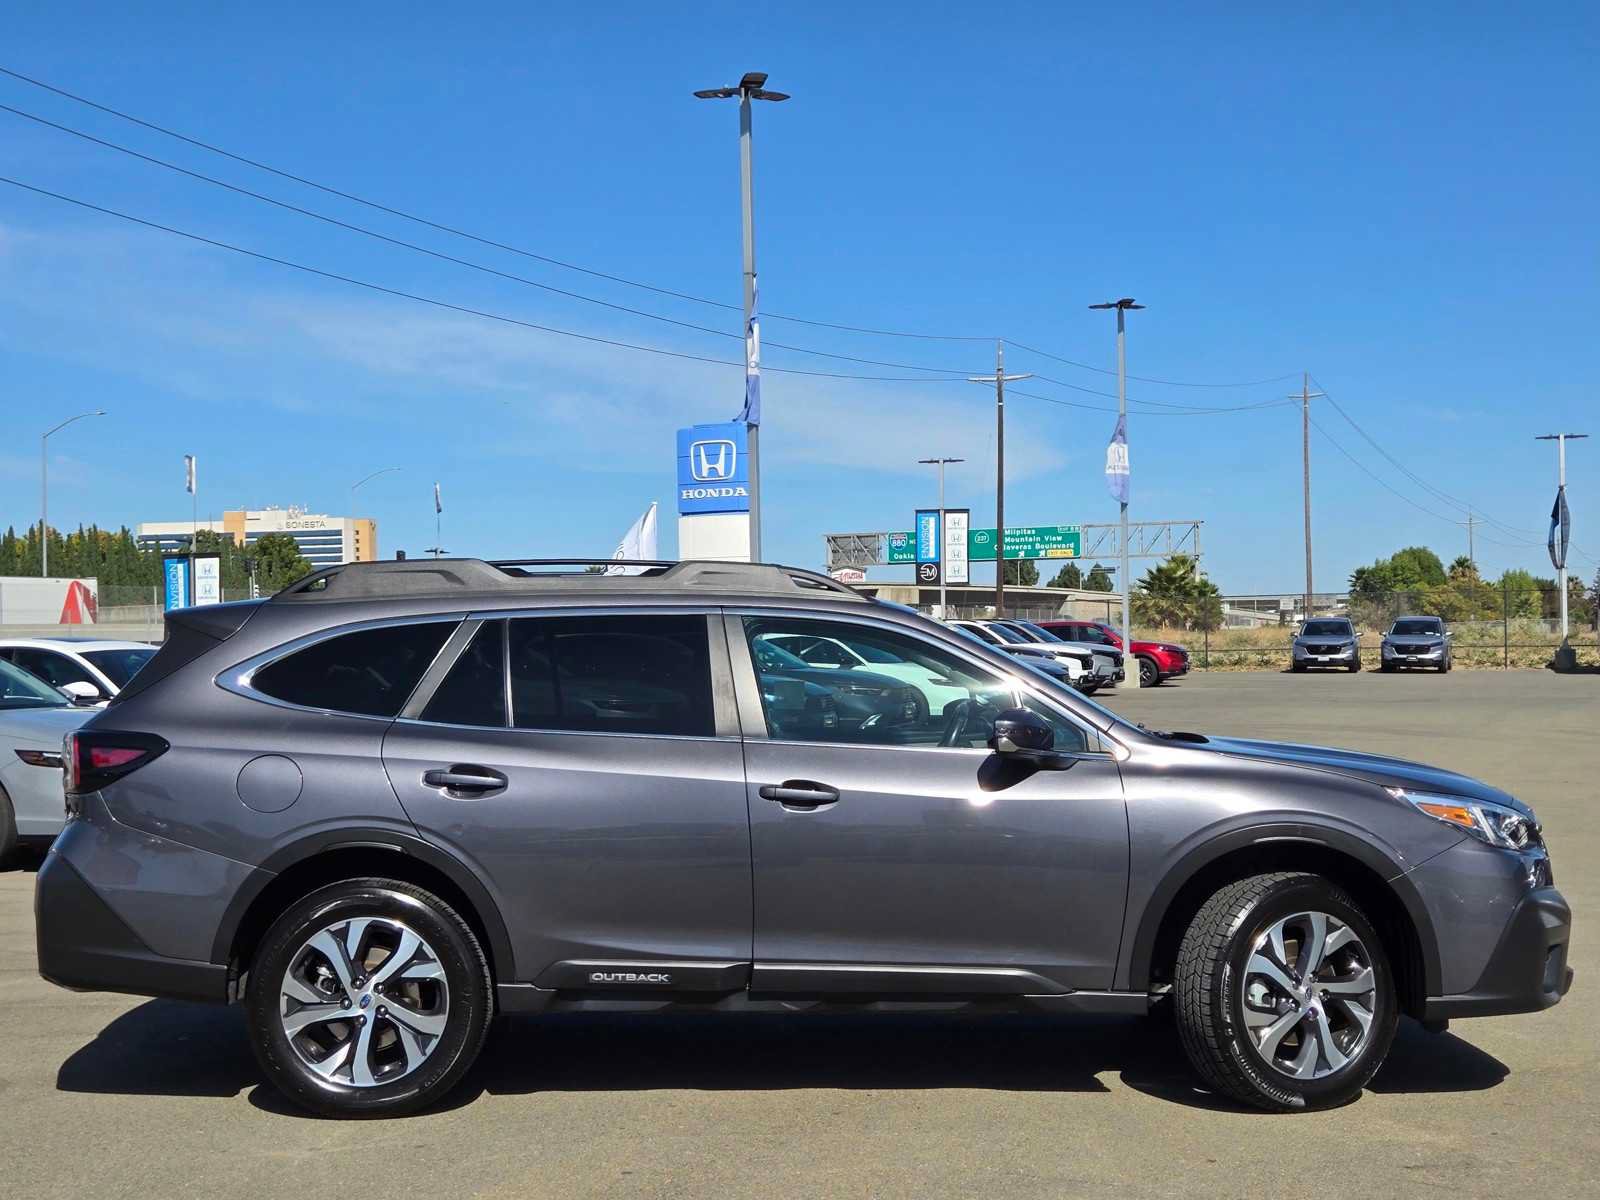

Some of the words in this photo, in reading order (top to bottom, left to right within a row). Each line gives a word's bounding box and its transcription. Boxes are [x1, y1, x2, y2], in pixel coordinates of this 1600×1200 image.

[682, 487, 749, 499] HONDA
[286, 520, 326, 528] SONESTA
[921, 517, 929, 559] ENVISION
[169, 564, 179, 609] NVISION
[591, 972, 670, 982] OUTBACK
